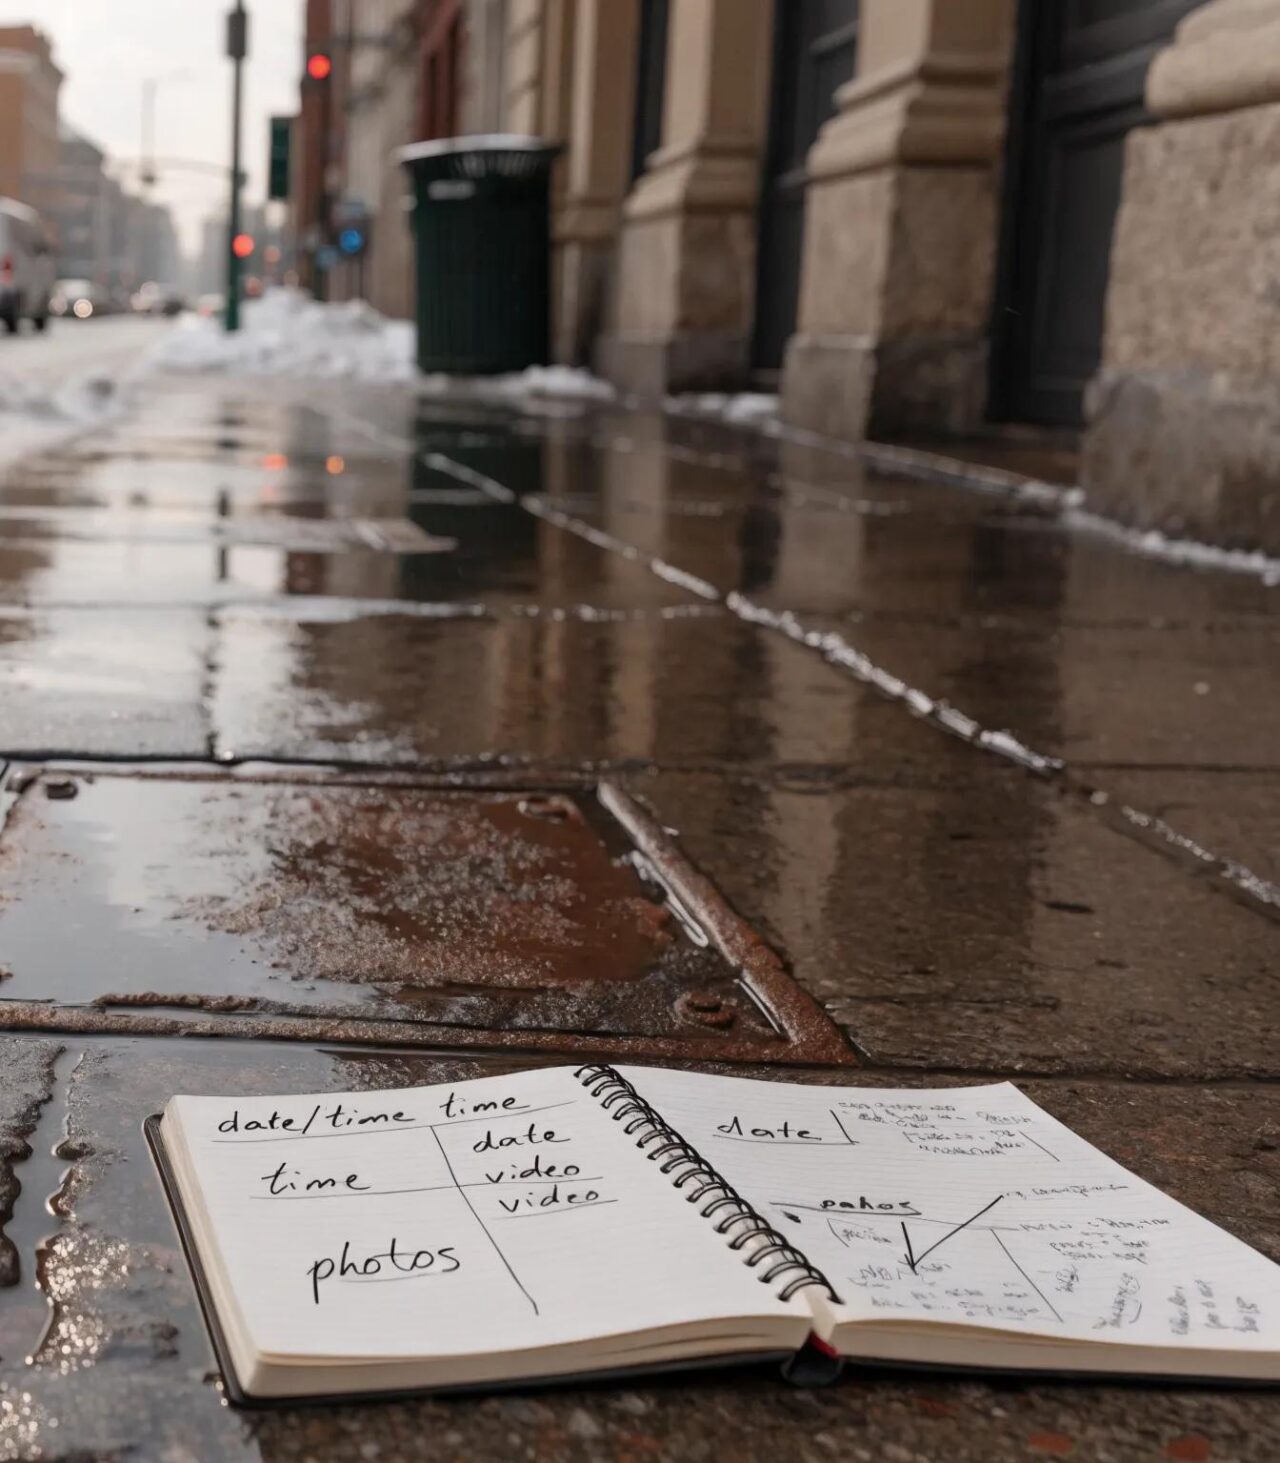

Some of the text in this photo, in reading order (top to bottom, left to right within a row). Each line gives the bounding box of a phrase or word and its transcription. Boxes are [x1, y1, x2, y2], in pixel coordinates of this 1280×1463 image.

[218, 1092, 531, 1135] date/time time
[472, 1123, 571, 1153] date
[716, 1116, 822, 1142] date
[261, 1162, 372, 1195] time
[485, 1155, 580, 1184] video
[499, 1184, 599, 1213] video
[306, 1238, 460, 1304] photos
